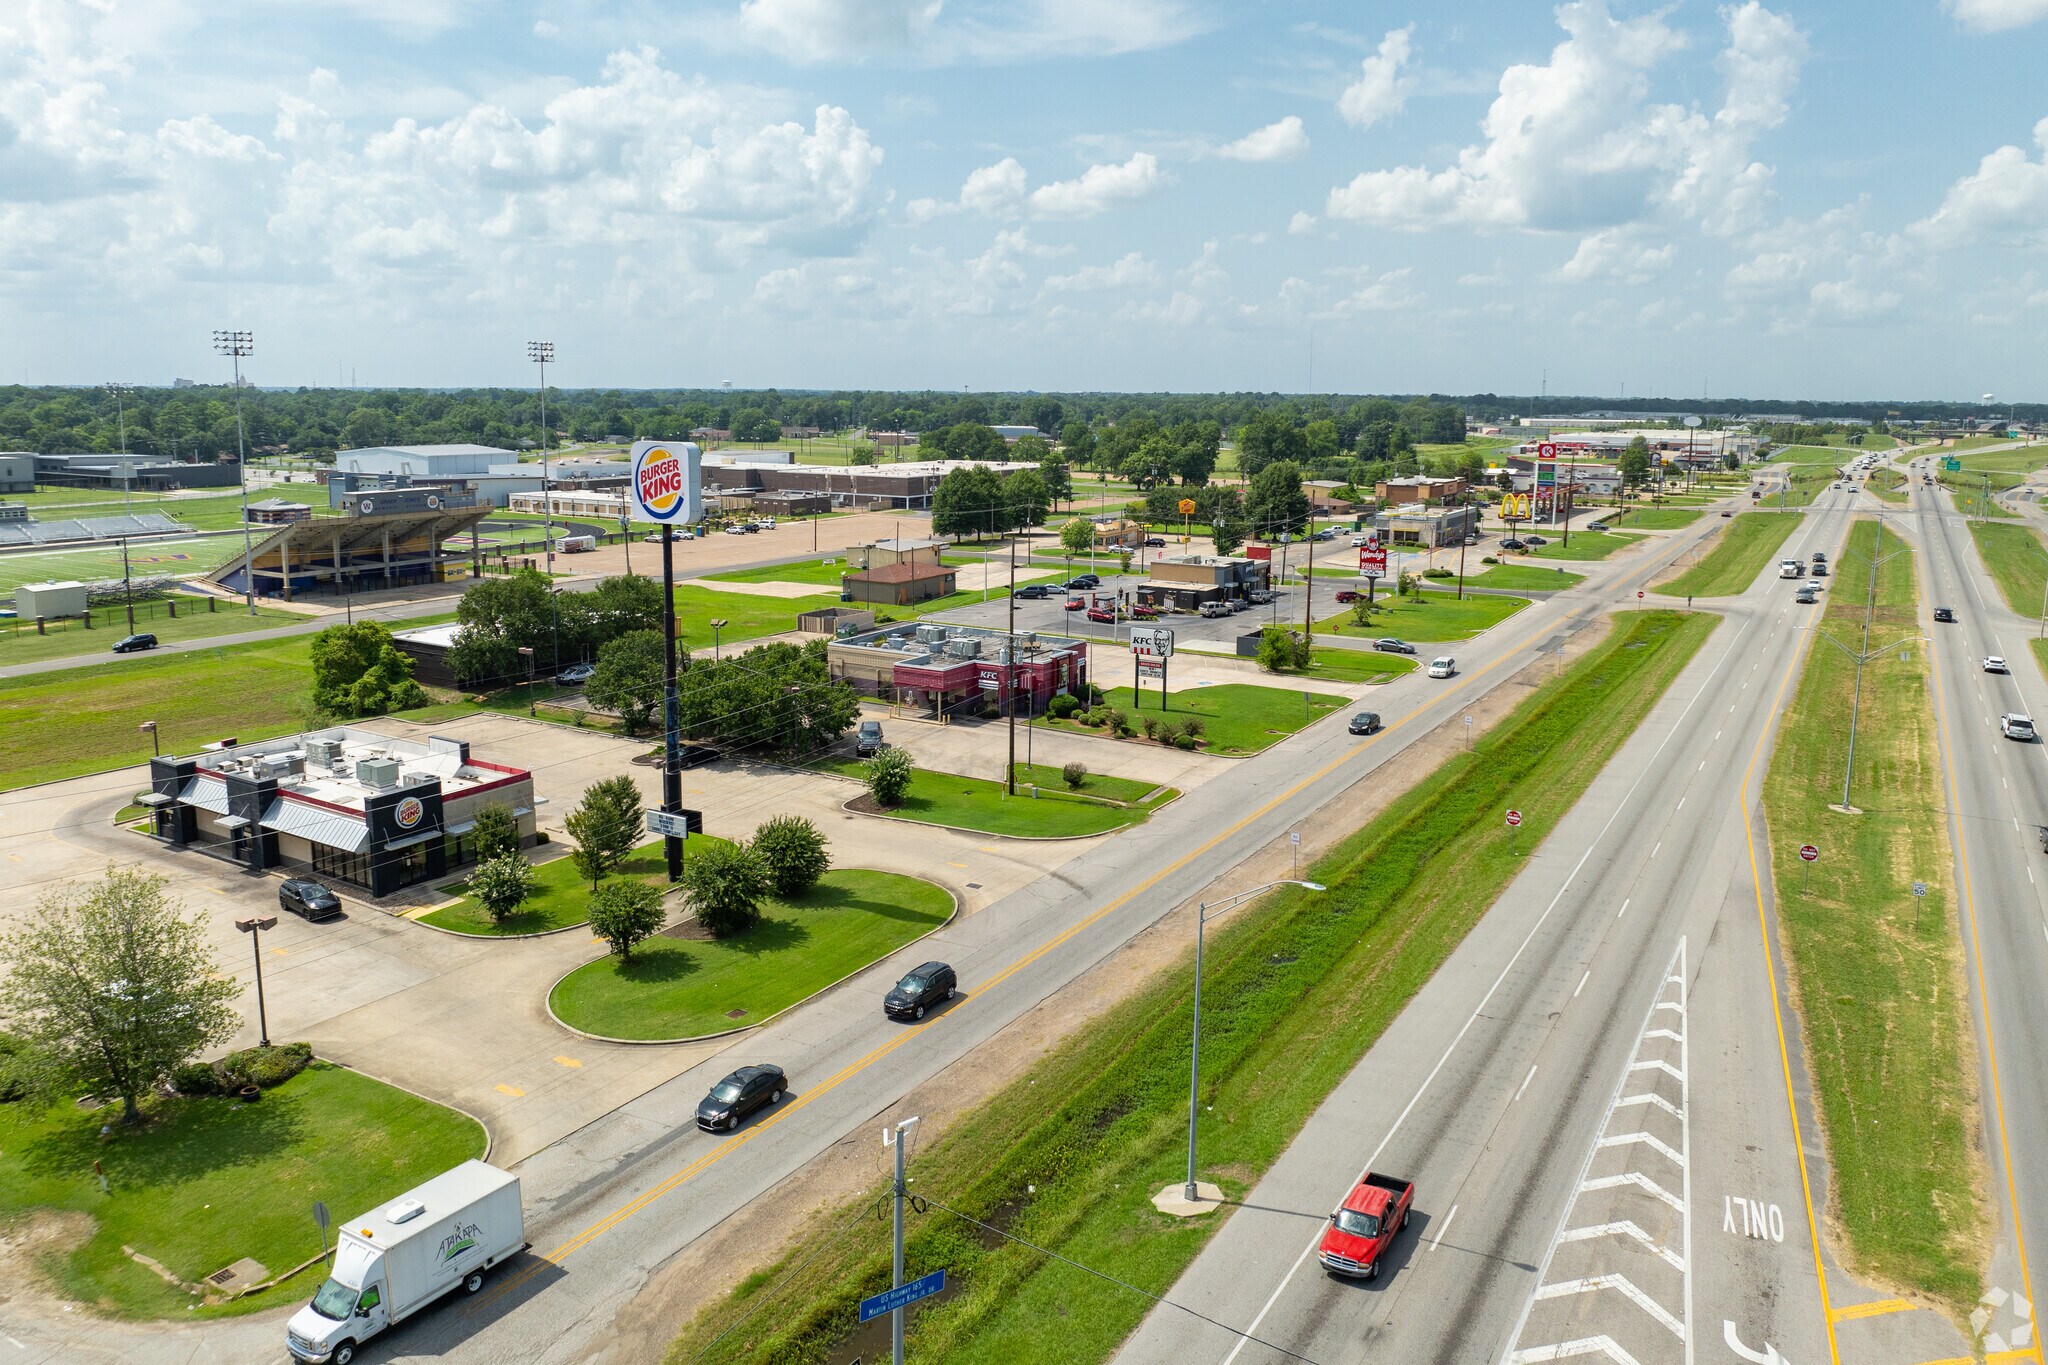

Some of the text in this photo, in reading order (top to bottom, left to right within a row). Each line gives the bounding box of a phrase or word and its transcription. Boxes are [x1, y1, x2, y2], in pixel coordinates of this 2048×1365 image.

[1545, 448, 1552, 456] K
[640, 459, 680, 485] BURGER
[642, 471, 682, 504] KING
[1133, 636, 1152, 645] KFC
[980, 670, 998, 680] KFC
[400, 802, 419, 816] BURGER
[401, 807, 420, 822] KING
[1723, 1195, 1784, 1243] ONLY
[433, 1223, 484, 1263] ATAKAPA
[880, 1293, 889, 1304] US
[890, 1287, 911, 1300] HIGHWAY
[868, 1304, 886, 1317] MARTIN
[887, 1298, 905, 1310] LUTHER
[906, 1293, 918, 1303] KING
